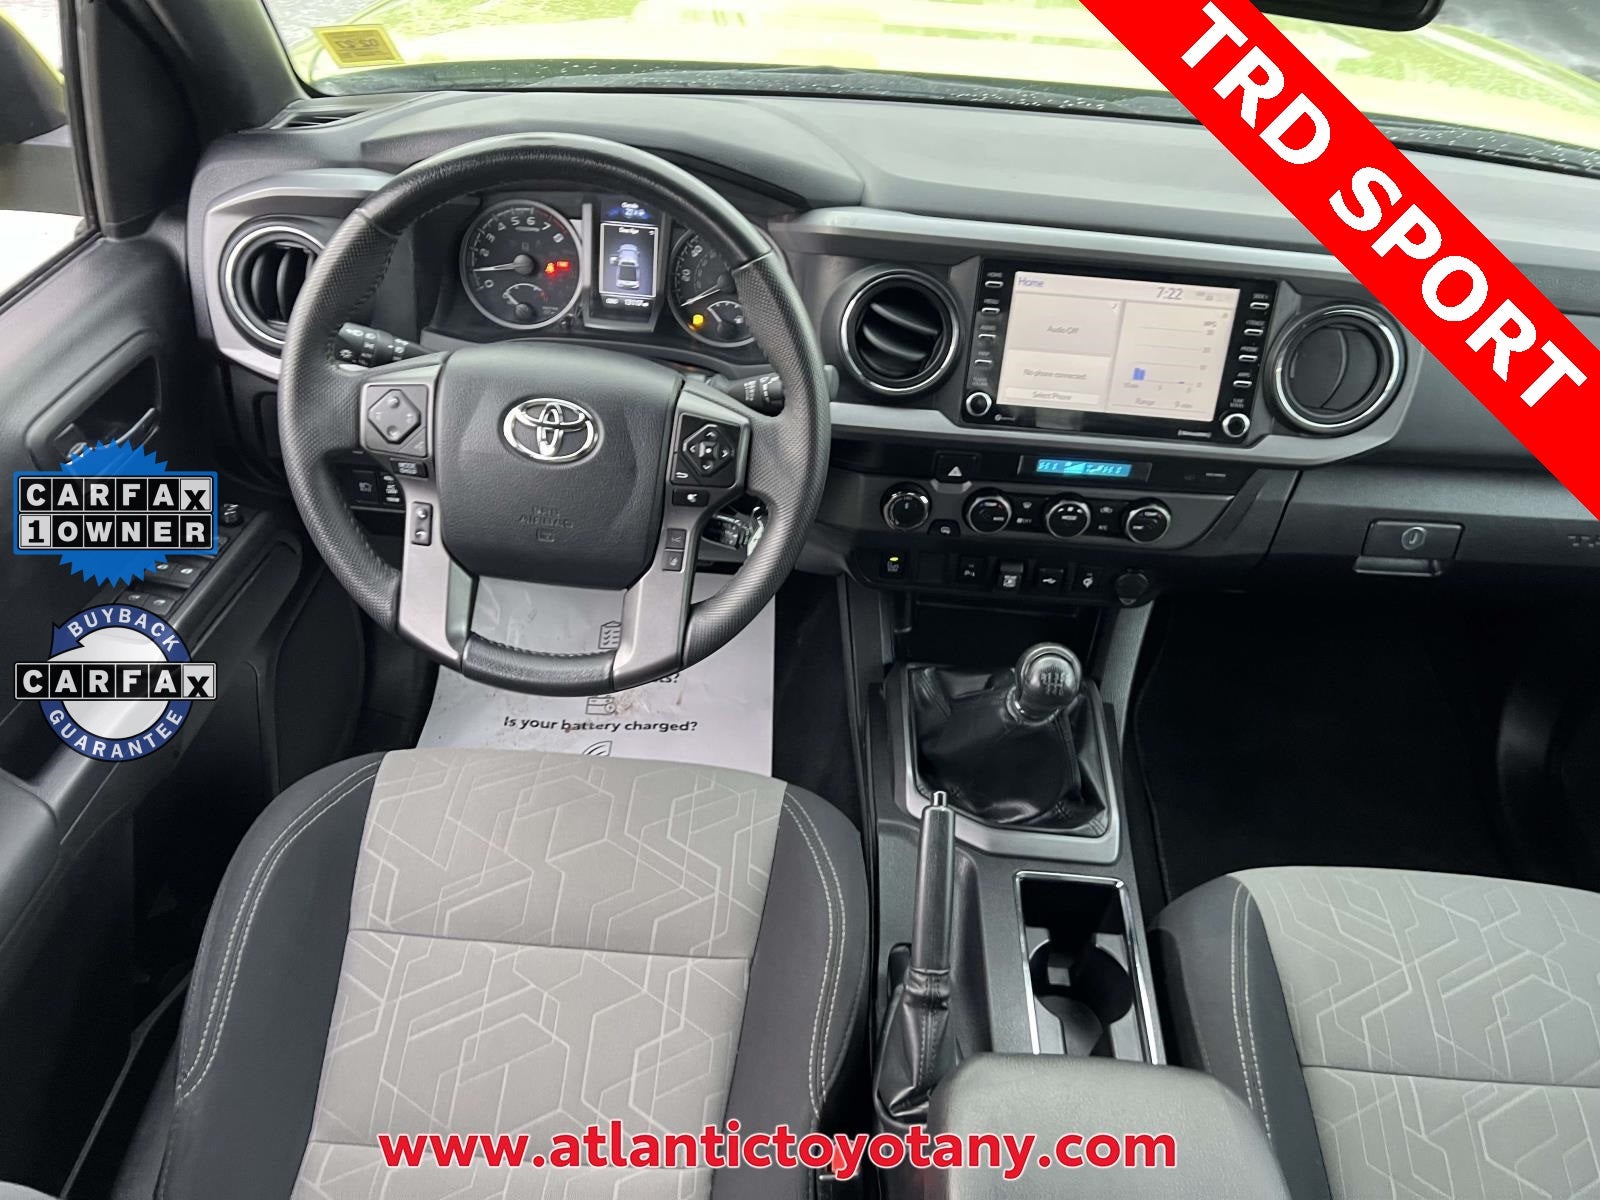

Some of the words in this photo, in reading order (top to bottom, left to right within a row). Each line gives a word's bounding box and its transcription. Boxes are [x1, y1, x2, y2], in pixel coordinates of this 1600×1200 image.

[1017, 276, 1045, 288] Home
[1155, 285, 1184, 300] 7:22
[503, 716, 518, 728] Is
[520, 718, 558, 731] your
[560, 717, 621, 733] battery
[624, 720, 698, 732] charged?
